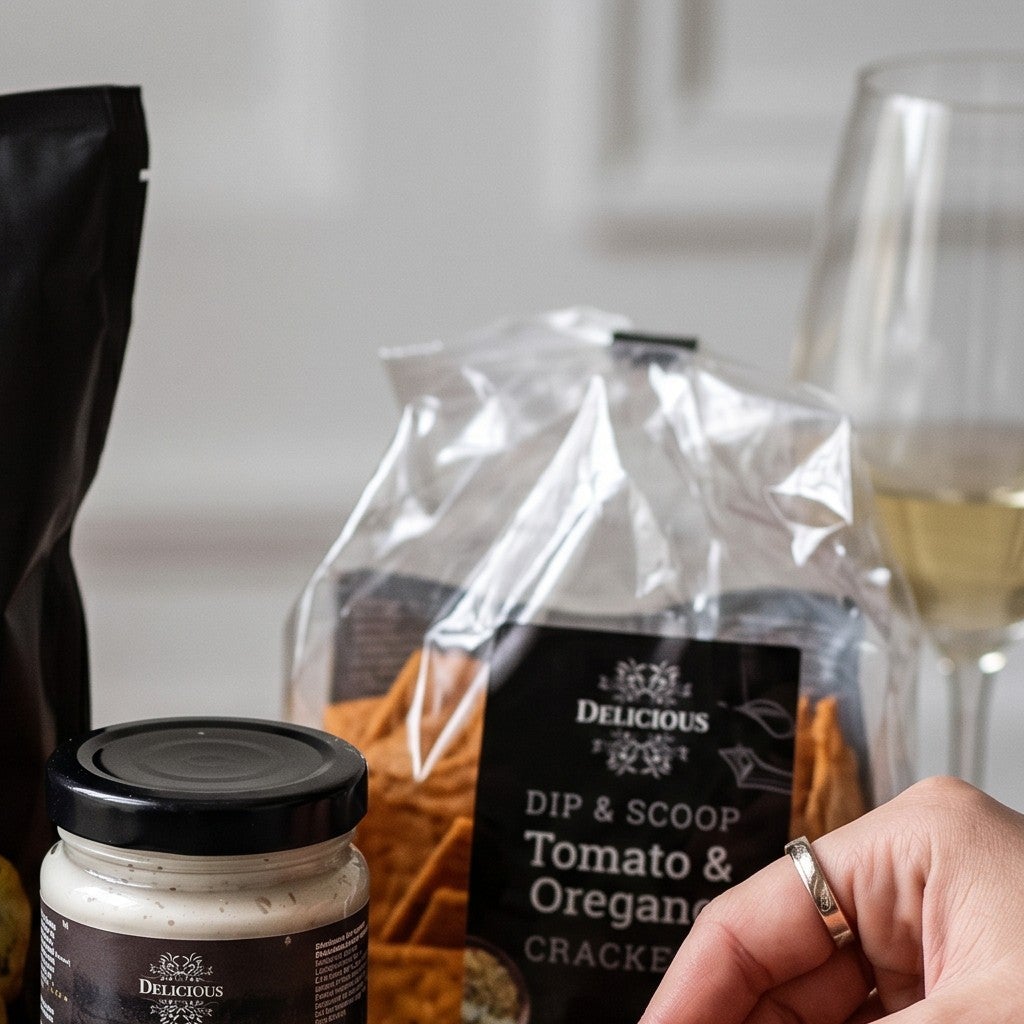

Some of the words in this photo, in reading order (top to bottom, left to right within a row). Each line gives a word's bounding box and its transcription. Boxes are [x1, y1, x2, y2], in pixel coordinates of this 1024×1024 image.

[576, 699, 711, 734] DELICIOUS
[526, 789, 583, 819] DIP
[593, 796, 615, 823] &
[626, 799, 741, 833] SCOOP
[524, 830, 691, 880] Tomato
[702, 846, 733, 882] &
[138, 978, 224, 998] DELICIOUS
